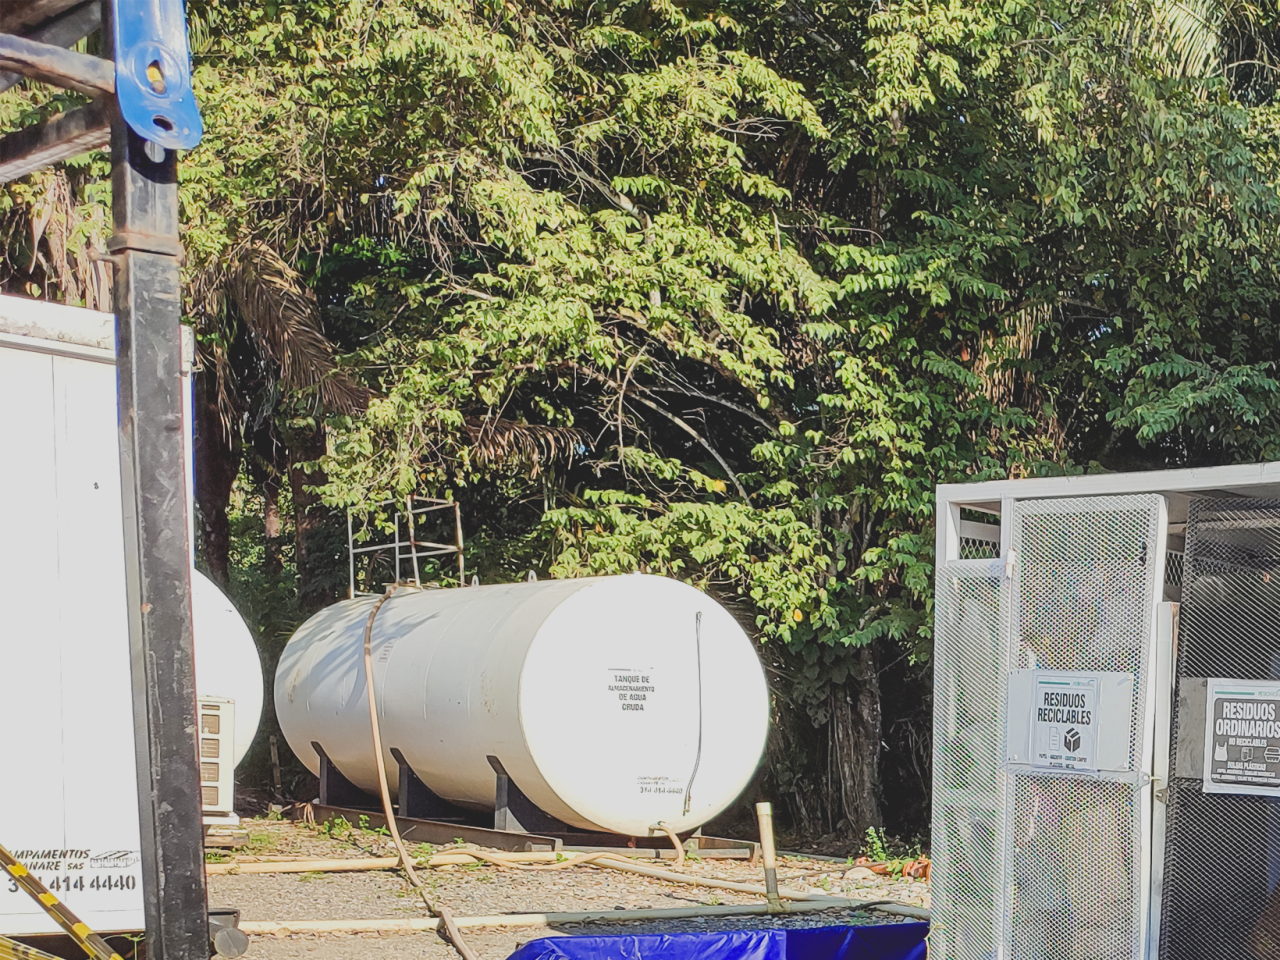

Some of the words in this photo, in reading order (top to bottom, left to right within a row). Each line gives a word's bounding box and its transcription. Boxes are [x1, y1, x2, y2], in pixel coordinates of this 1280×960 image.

[614, 675, 640, 684] TANQUE
[629, 693, 647, 701] AGUA
[1044, 692, 1086, 708] RESIDUOS
[622, 703, 645, 711] CRUDA
[1223, 702, 1276, 720] RESIDUOS
[1037, 707, 1092, 725] RECICLABLES
[8, 849, 91, 860] MPAMENTOS
[50, 876, 85, 892] 414
[90, 875, 136, 891] 4440
